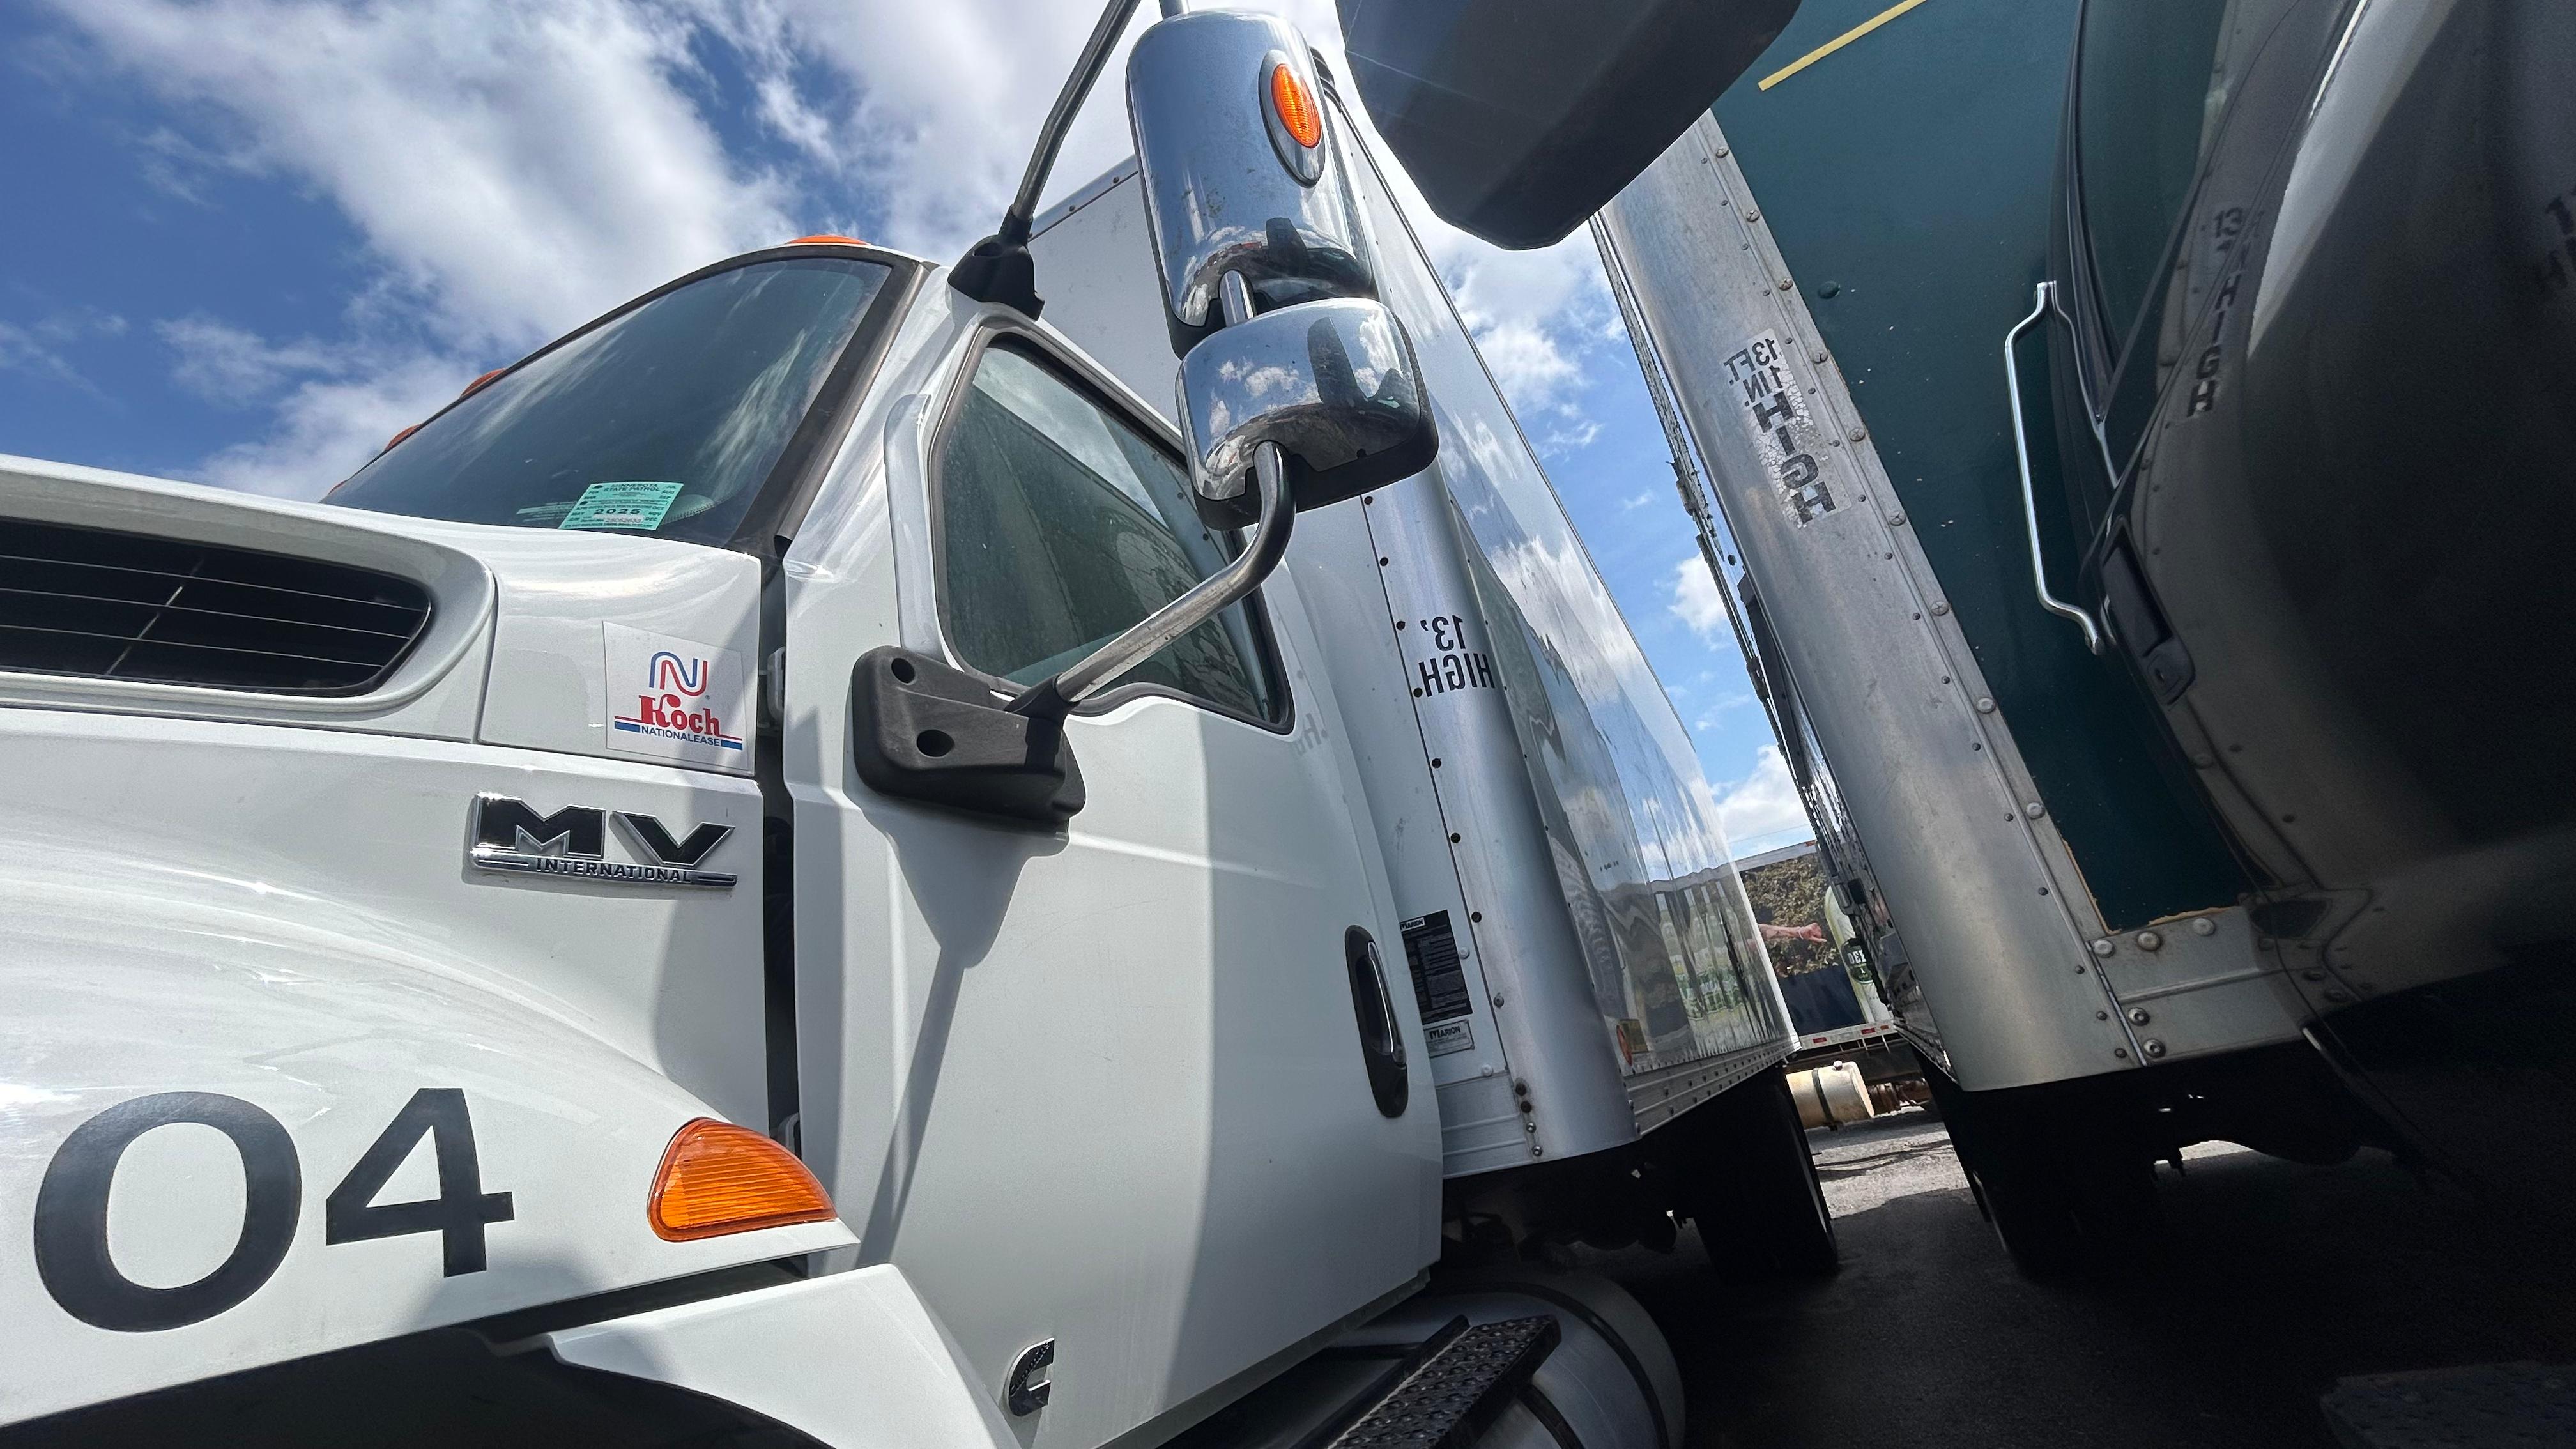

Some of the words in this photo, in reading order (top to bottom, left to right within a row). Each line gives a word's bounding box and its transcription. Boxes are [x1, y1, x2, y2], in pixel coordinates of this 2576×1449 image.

[638, 694, 721, 737] Koch
[641, 725, 721, 747] NATIONALEASE
[473, 791, 736, 867] MV
[535, 856, 693, 885] INTERNATIONAL
[1429, 1025, 1461, 1041] MARION
